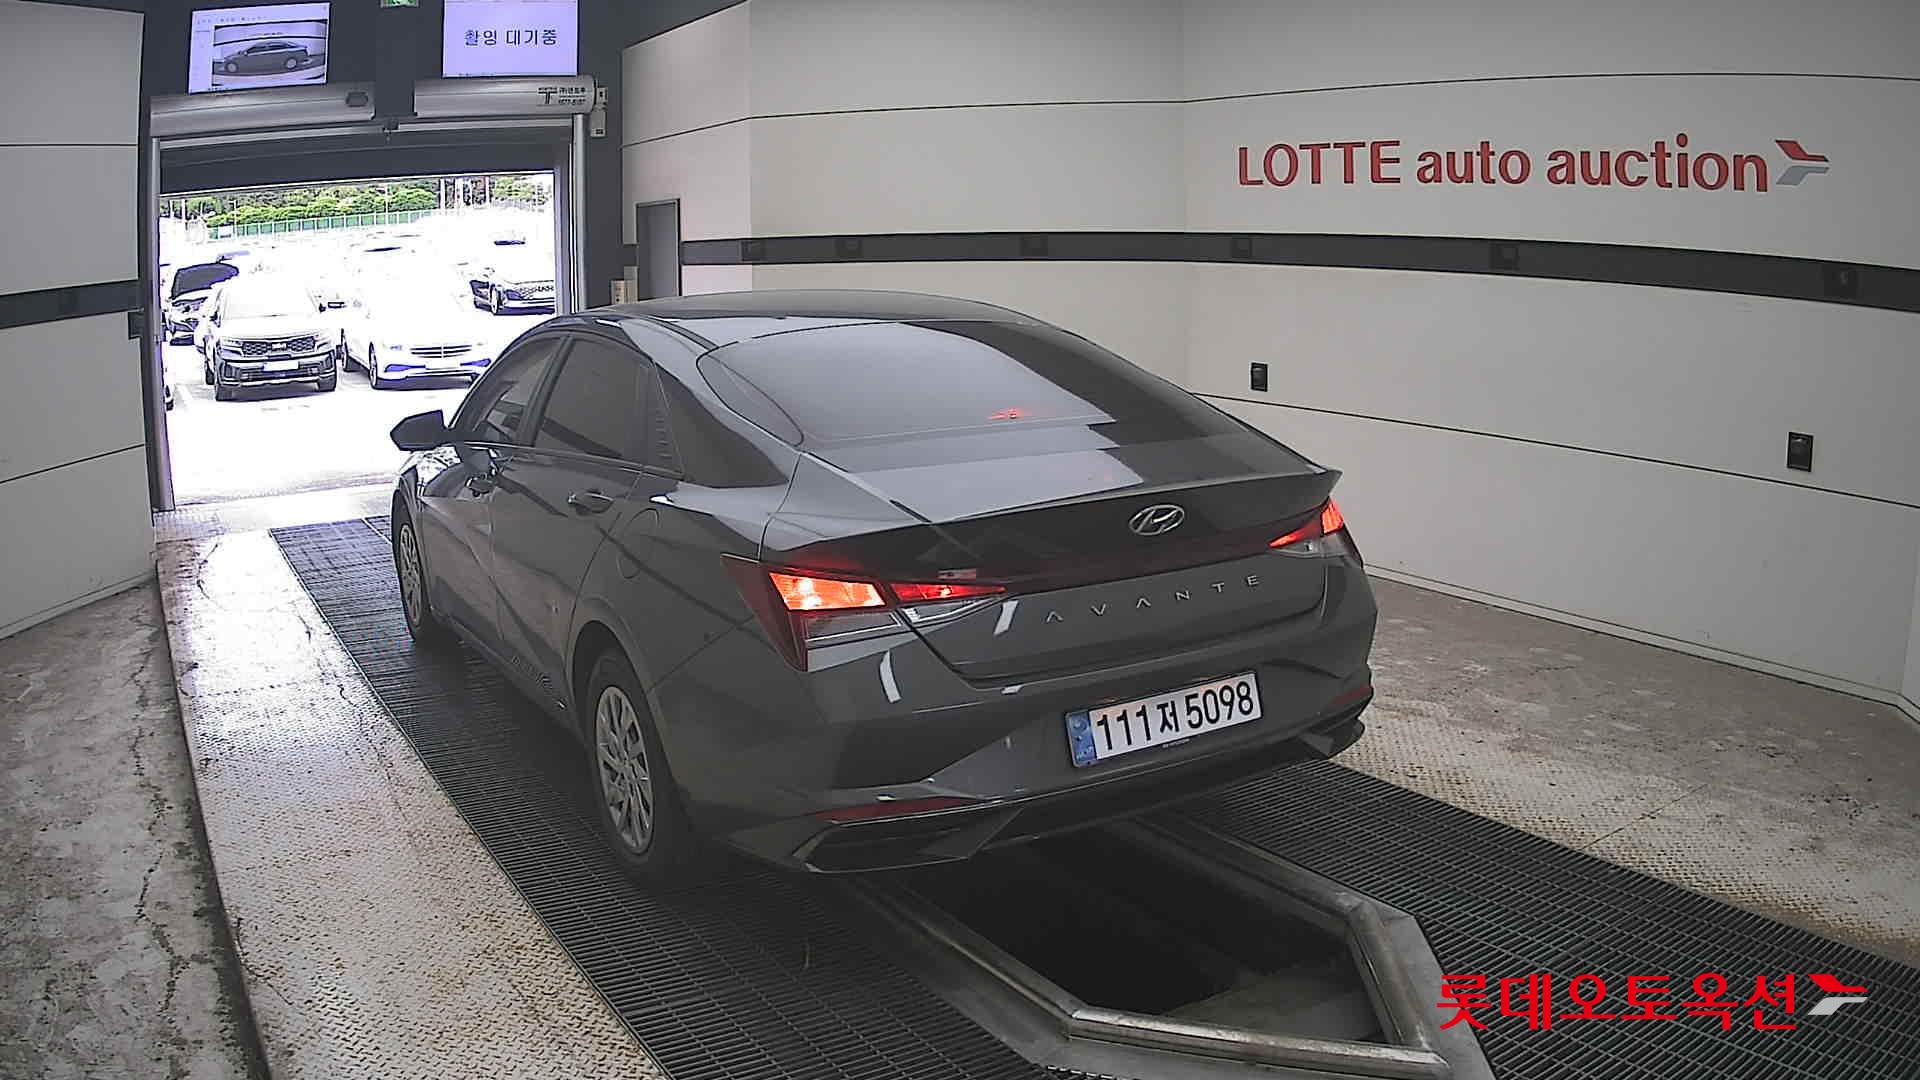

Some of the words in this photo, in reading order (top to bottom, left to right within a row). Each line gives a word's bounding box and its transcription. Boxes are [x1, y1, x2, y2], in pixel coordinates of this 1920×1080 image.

[505, 29, 558, 46] 대기중
[1238, 139, 1401, 187] LOTTE
[1416, 140, 1531, 185] auto
[1547, 132, 1768, 193] auction
[1046, 575, 1260, 623] AVANTE
